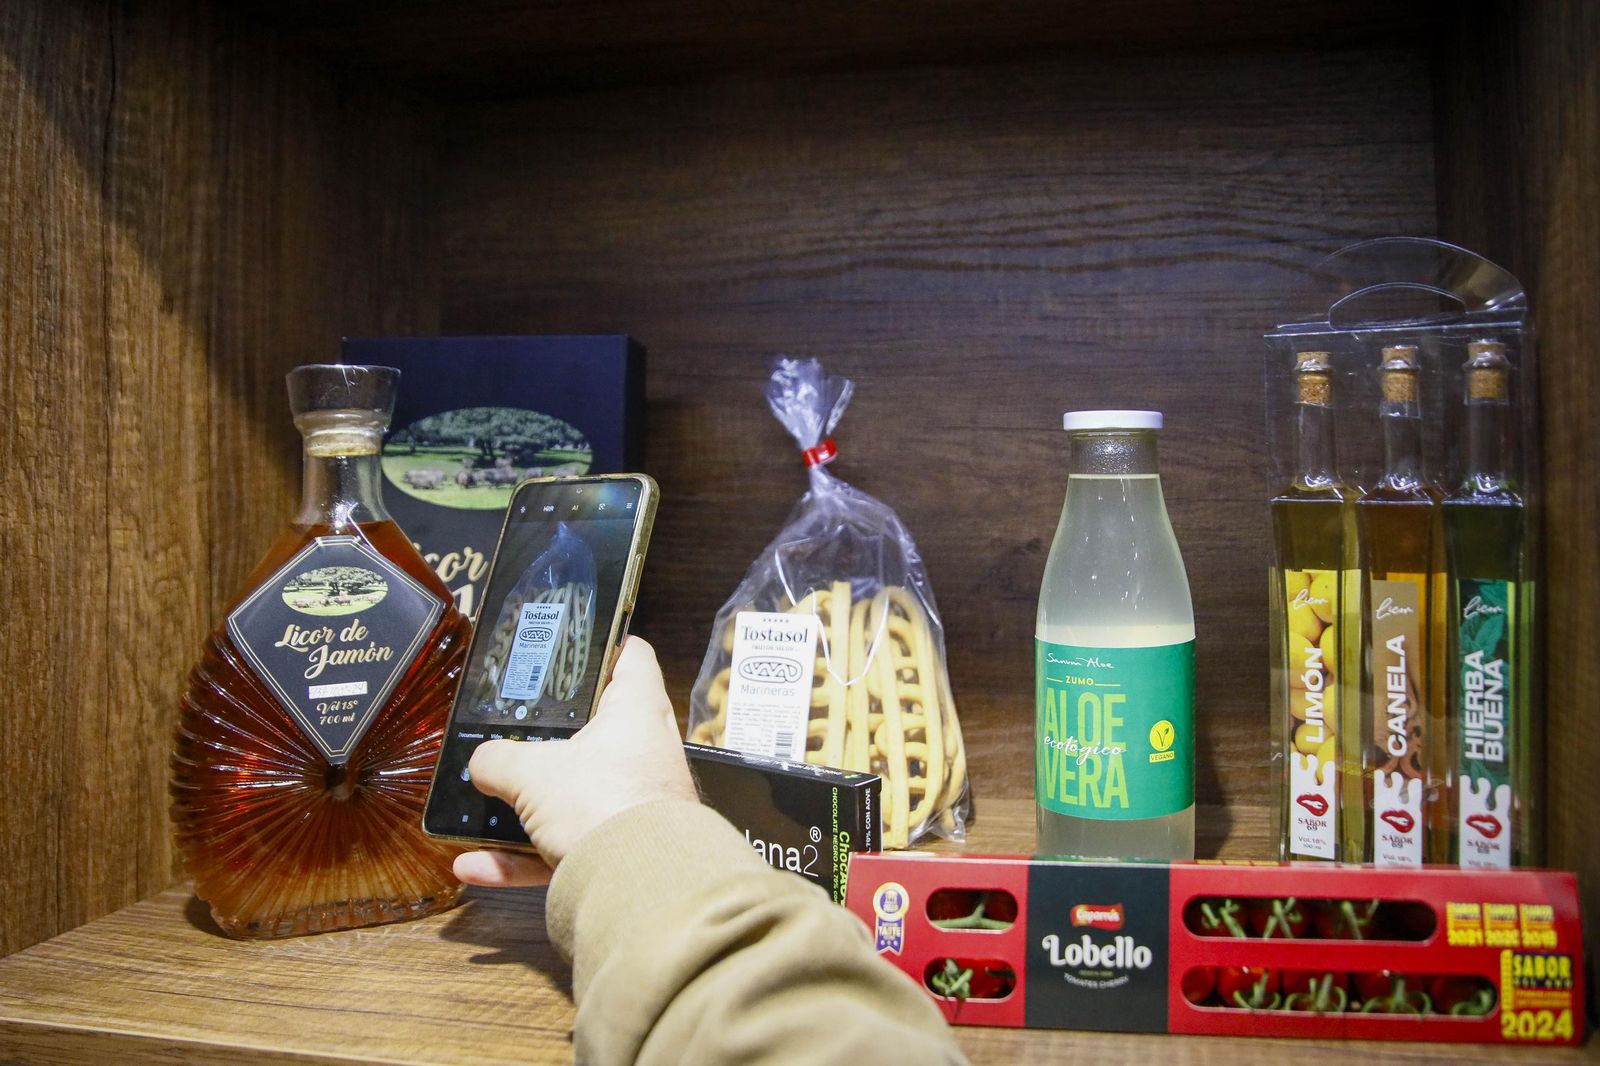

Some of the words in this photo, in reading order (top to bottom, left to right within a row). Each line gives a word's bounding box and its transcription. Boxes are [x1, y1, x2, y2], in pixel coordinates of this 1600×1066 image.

[523, 610, 560, 620] Tostasol
[274, 623, 336, 653] Licor
[339, 618, 369, 643] de
[741, 625, 808, 643] Tostasol
[304, 641, 394, 680] Jamón
[1080, 656, 1115, 669] Aloe
[740, 684, 796, 697] Marineras
[1065, 675, 1095, 686] ZUMO
[1300, 646, 1324, 743] LIMÓN
[1386, 634, 1408, 757] CANELA
[319, 714, 341, 726] 700
[342, 711, 356, 723] ml
[1044, 687, 1127, 750] ALOE
[1464, 649, 1485, 760] HIERBA
[1484, 658, 1504, 763] BUENA
[1044, 735, 1122, 766] ecológico
[1150, 752, 1174, 762] VEGANO
[1044, 750, 1130, 808] VERA
[1297, 817, 1327, 829] SABOR
[832, 862, 839, 872] AL
[1042, 934, 1153, 969] Lobello
[1513, 954, 1571, 978] SABOR
[1501, 1008, 1574, 1040] 2024
